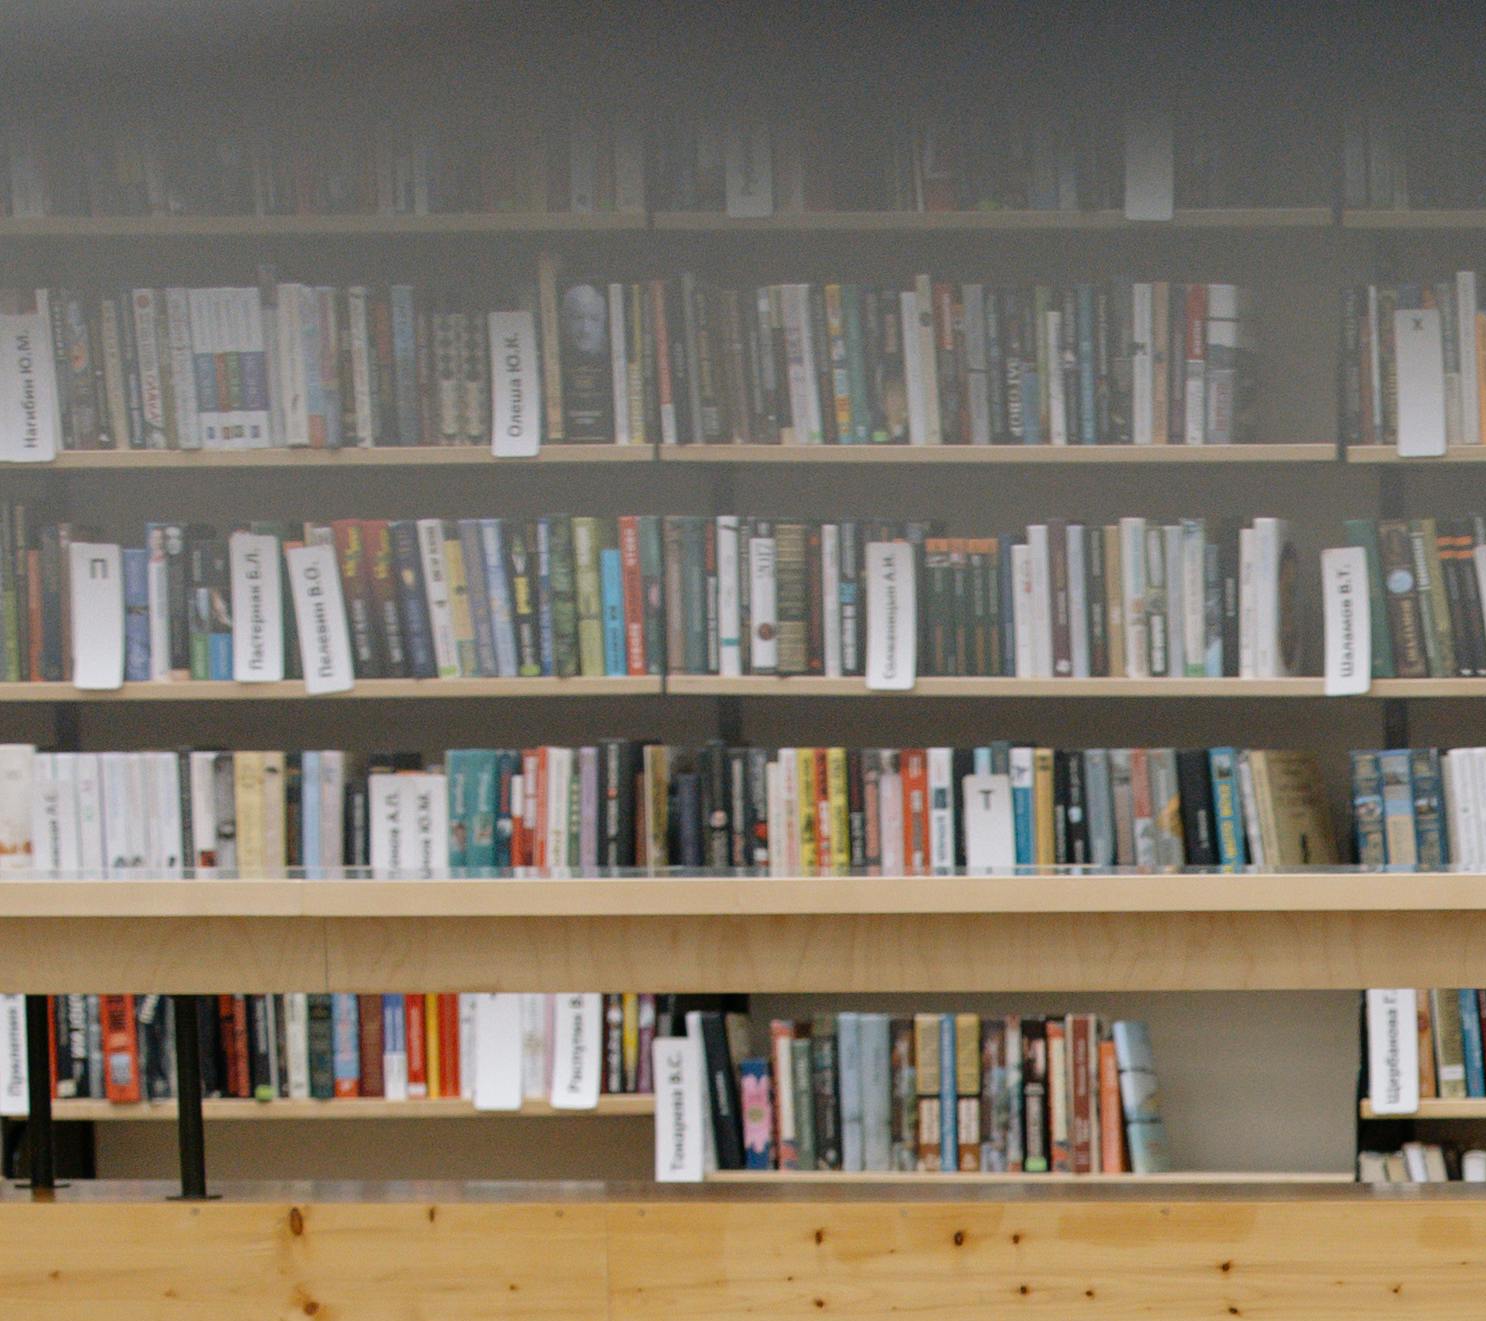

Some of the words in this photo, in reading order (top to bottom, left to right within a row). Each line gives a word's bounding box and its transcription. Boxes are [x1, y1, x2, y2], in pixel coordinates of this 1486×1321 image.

[16, 330, 35, 374] Ю.М.
[503, 333, 522, 373] Ю.К.
[20, 378, 38, 448] Нагибин
[507, 379, 524, 438] Олеша
[245, 548, 260, 580] Б.Л.
[247, 585, 264, 670] Пастернак
[312, 602, 333, 677] Пелевин
